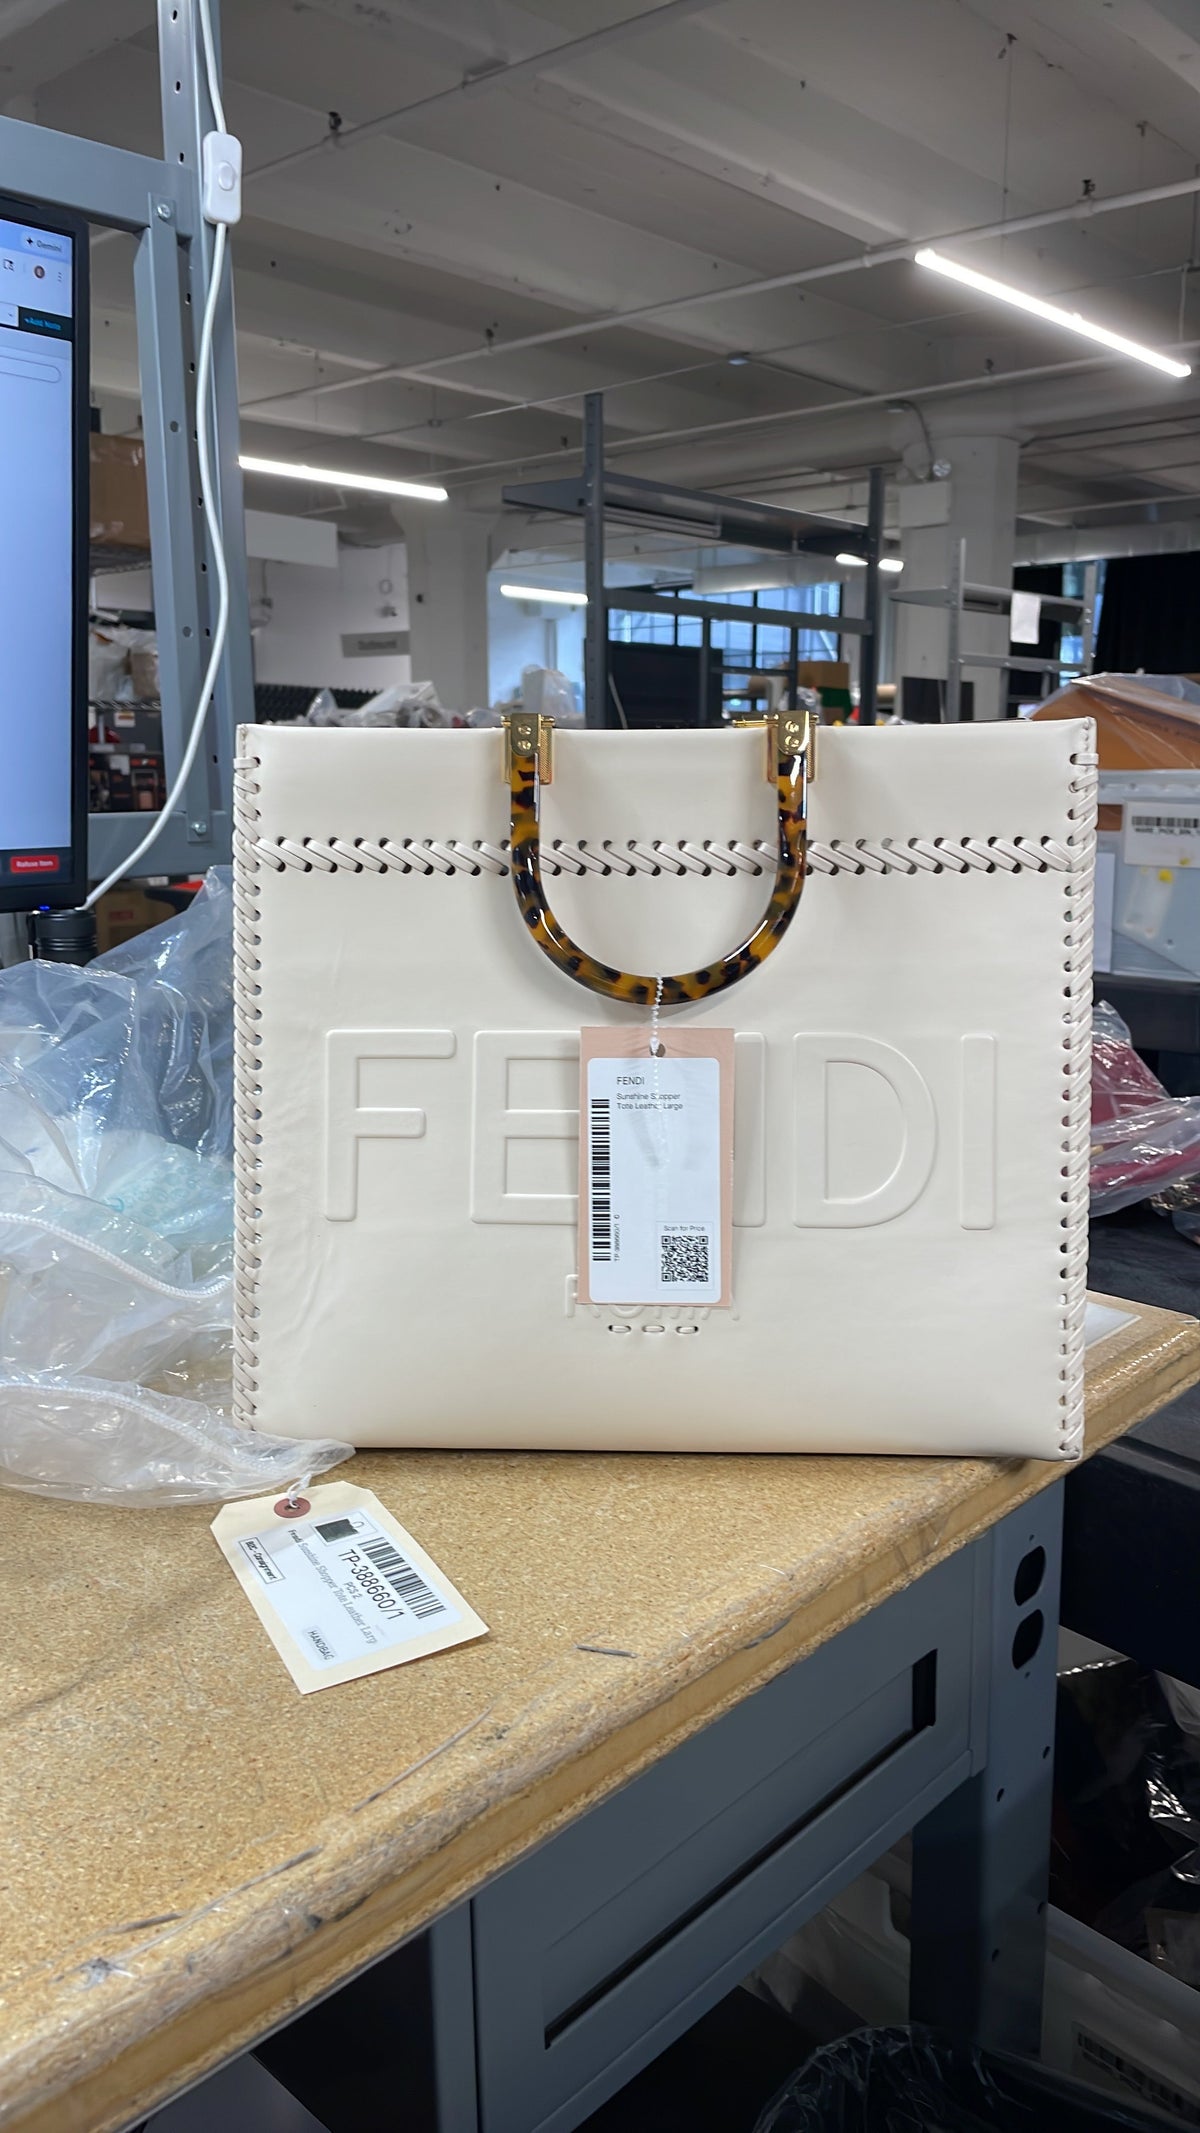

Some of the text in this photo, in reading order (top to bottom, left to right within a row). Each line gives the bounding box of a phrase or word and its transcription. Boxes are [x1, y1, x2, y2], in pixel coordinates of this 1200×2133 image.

[616, 1076, 645, 1086] FENDI
[616, 1092, 681, 1102] Sunshine Sopper
[616, 1102, 634, 1110] Tote
[663, 1102, 684, 1111] Large
[325, 1028, 998, 1231] FEDI
[689, 1224, 706, 1232] Price
[288, 1529, 304, 1543] Fendi
[298, 1543, 321, 1567] Sunshine
[315, 1565, 338, 1588] Shopper
[333, 1588, 348, 1603] Tote
[343, 1601, 366, 1626] Leather
[338, 1549, 405, 1620] TP-388660/1
[343, 1581, 359, 1594] PCS
[307, 1629, 335, 1660] HANDBAG
